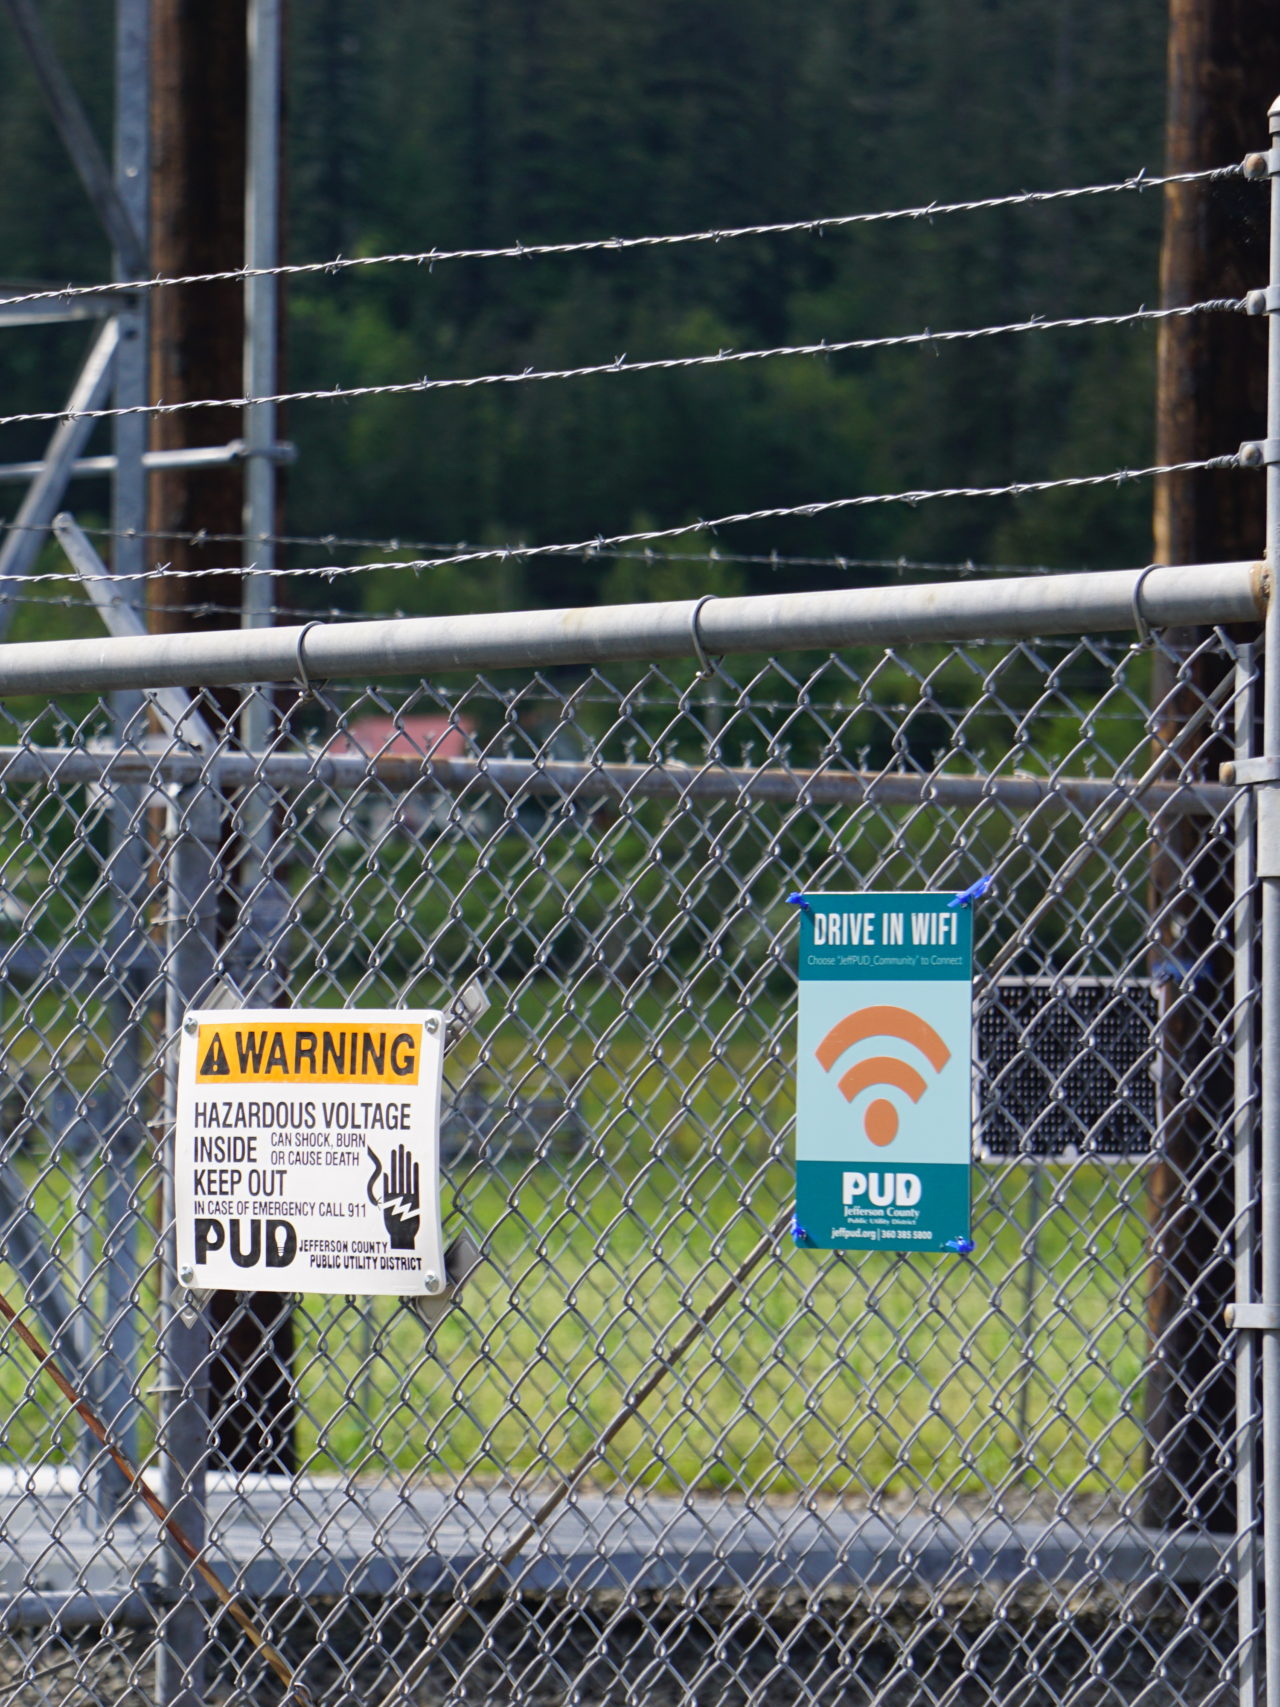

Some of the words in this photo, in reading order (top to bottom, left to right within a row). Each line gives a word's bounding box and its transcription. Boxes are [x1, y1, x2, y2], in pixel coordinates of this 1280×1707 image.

[814, 912, 875, 946] DRIVE
[882, 912, 904, 946] IN
[911, 912, 958, 946] WIFI
[807, 955, 835, 965] Choose
[921, 955, 929, 965] to
[931, 955, 963, 965] Connect
[235, 1031, 415, 1076] WARNING
[194, 1101, 316, 1129] HAZARDOUS
[322, 1102, 411, 1130] VOLTAGE
[194, 1136, 257, 1163] INSIDE
[271, 1132, 292, 1147] CAN
[294, 1132, 333, 1150] SHOCK,
[336, 1133, 366, 1148] BURN
[271, 1151, 286, 1166] OR
[288, 1151, 322, 1166] CAUSE
[325, 1151, 360, 1166] DEATH
[194, 1169, 242, 1196] KEEP
[248, 1169, 288, 1197] OUT
[842, 1171, 922, 1206] PUD
[194, 1200, 205, 1214] IN
[207, 1200, 234, 1215] CASE
[236, 1201, 250, 1215] OF
[252, 1201, 316, 1217] EMERGENCY
[319, 1202, 345, 1217] CALL
[347, 1203, 367, 1218] 911
[843, 1205, 884, 1217] Jefferson
[886, 1206, 920, 1219] County
[831, 1227, 876, 1240] jeffpud.org
[194, 1218, 297, 1268] PUD
[299, 1239, 348, 1253] JEFFERSON
[351, 1240, 388, 1254] COUNTY
[310, 1255, 340, 1269] PUBLIC
[344, 1256, 378, 1270] UTILITY
[380, 1256, 422, 1271] DISTRICT
